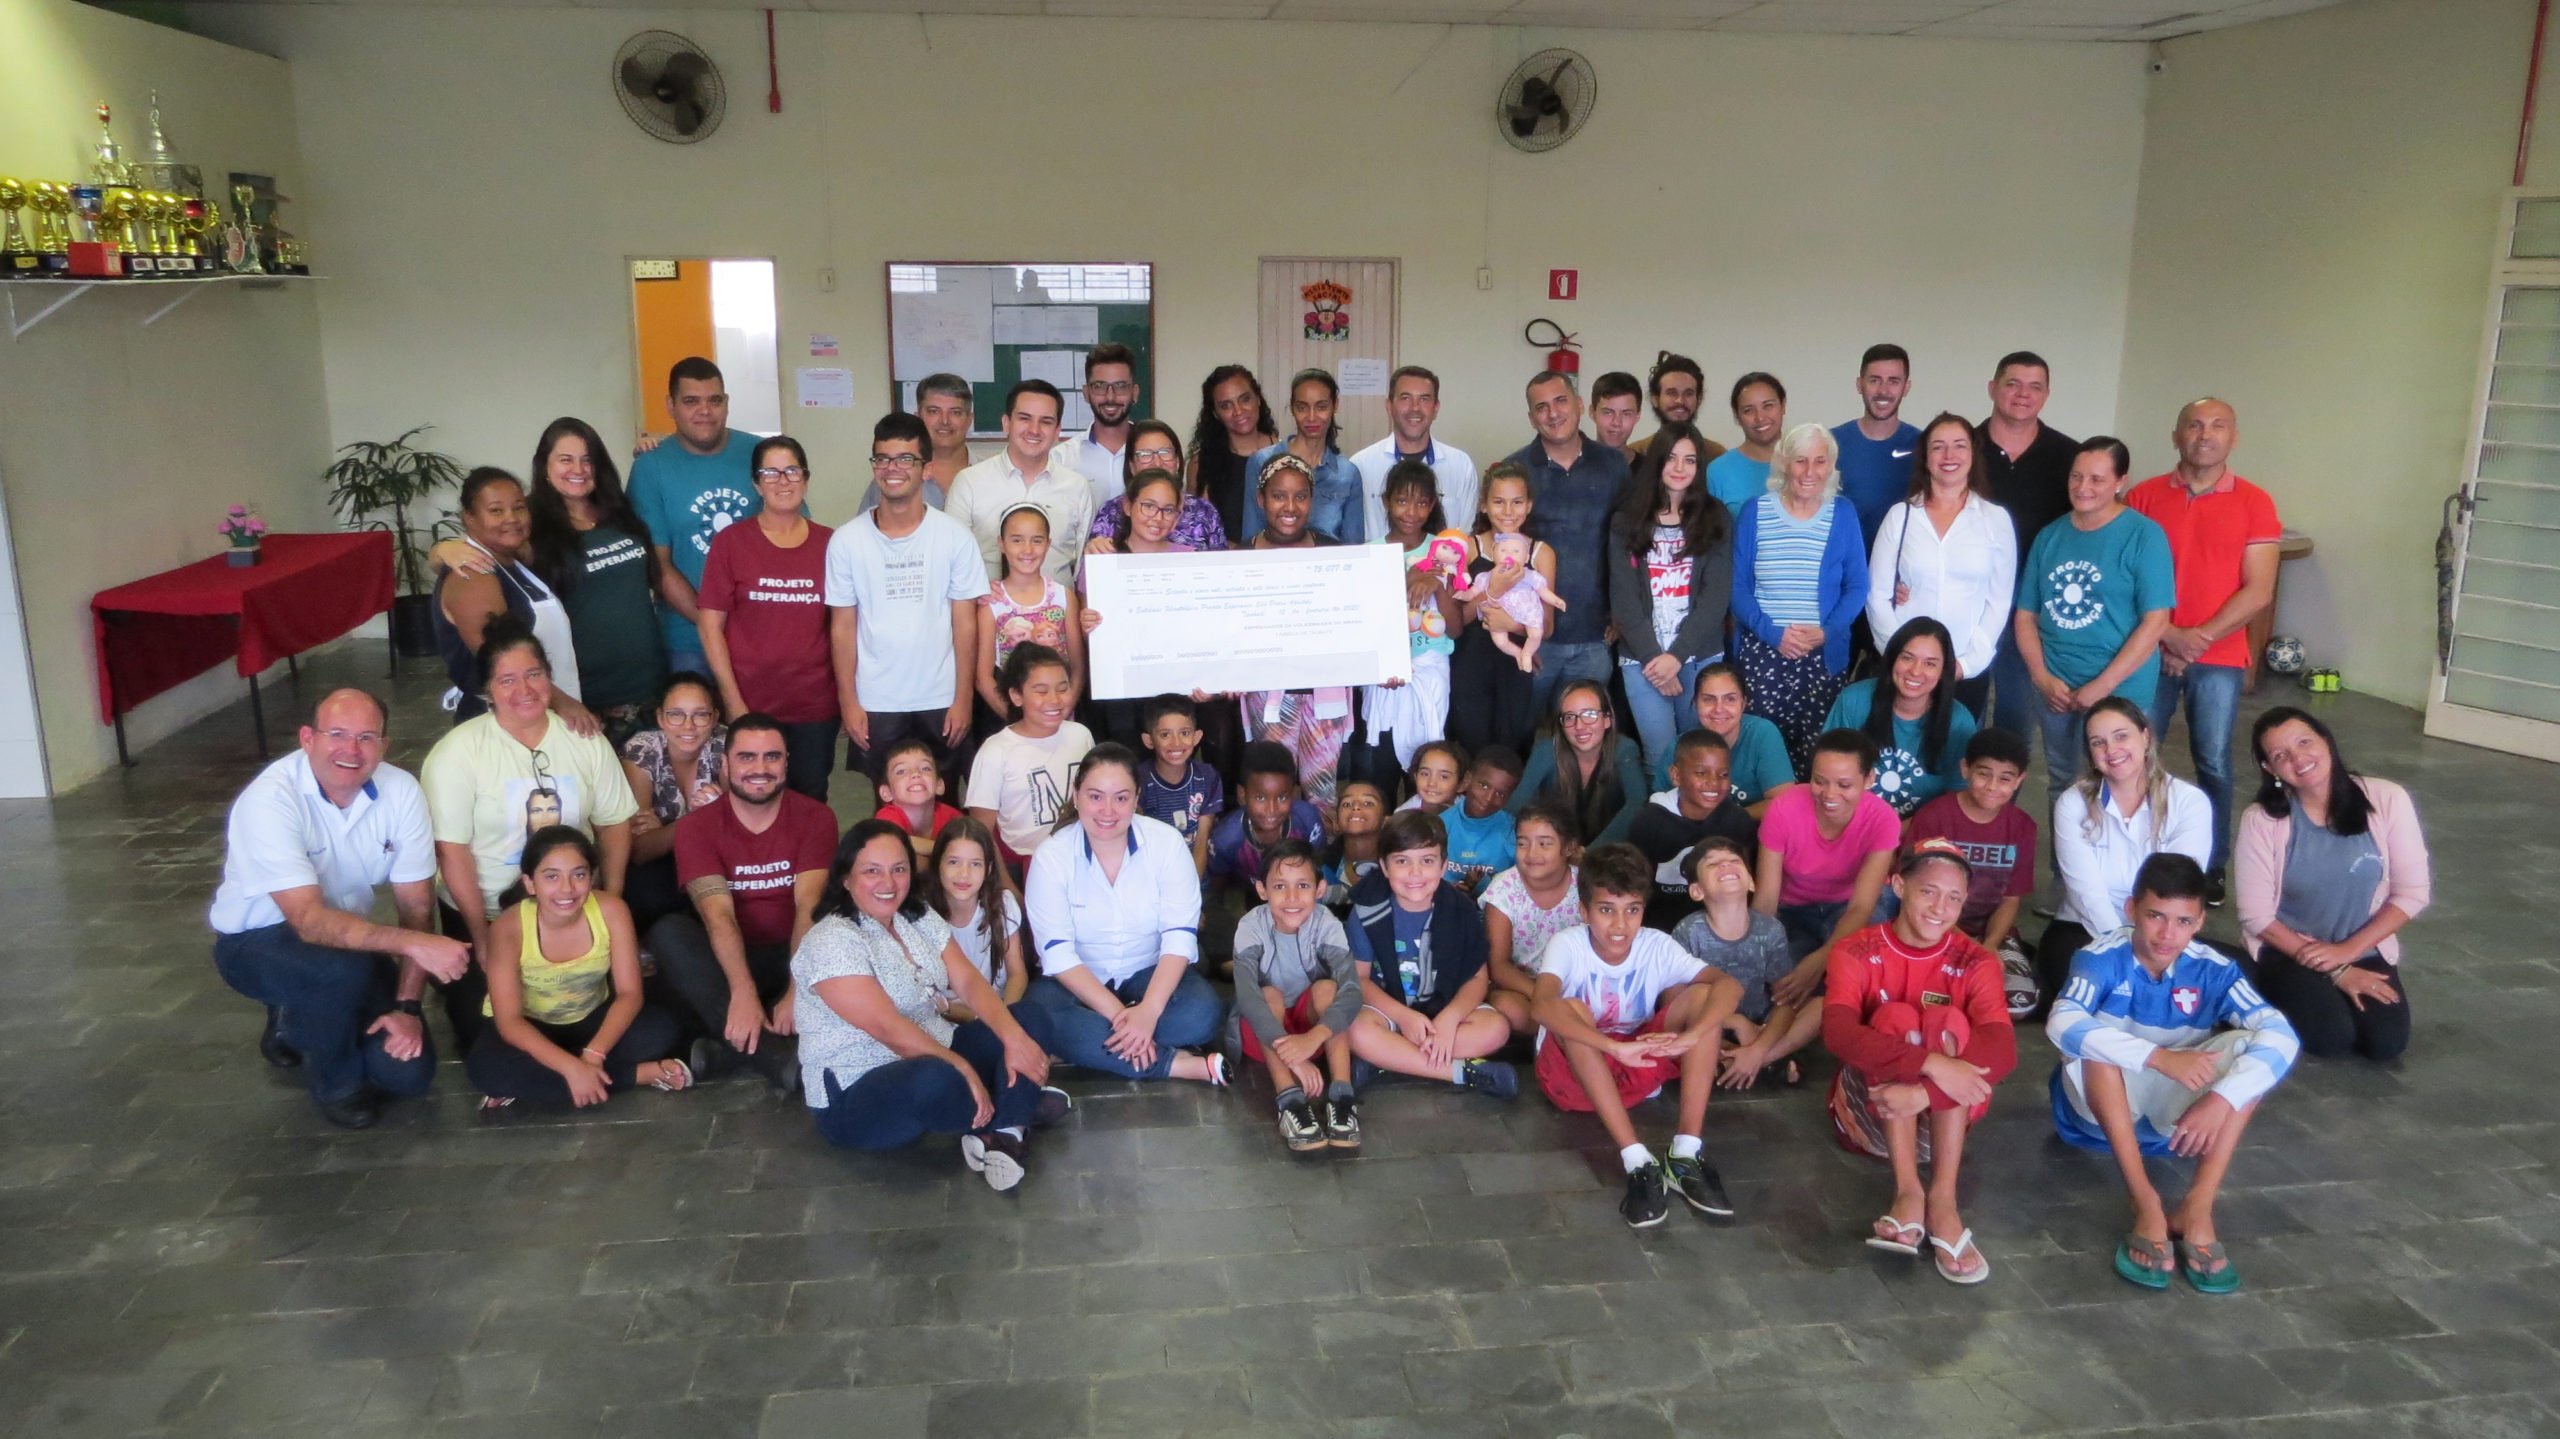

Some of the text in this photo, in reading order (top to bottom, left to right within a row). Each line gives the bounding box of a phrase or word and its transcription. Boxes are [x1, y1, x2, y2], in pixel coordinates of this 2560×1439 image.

[690, 488, 749, 514] PROJETO
[586, 538, 634, 558] PROJETO
[2048, 560, 2102, 583] PROJETO
[759, 577, 815, 588] PROJETO
[749, 591, 820, 604] ESPERANÇA
[2044, 600, 2104, 630] ESPERANÇA
[1879, 746, 1924, 777] OJETO
[1959, 845, 2014, 864] EBEL
[735, 860, 791, 876] PROJETO
[728, 874, 797, 892] ESPERANÇ
